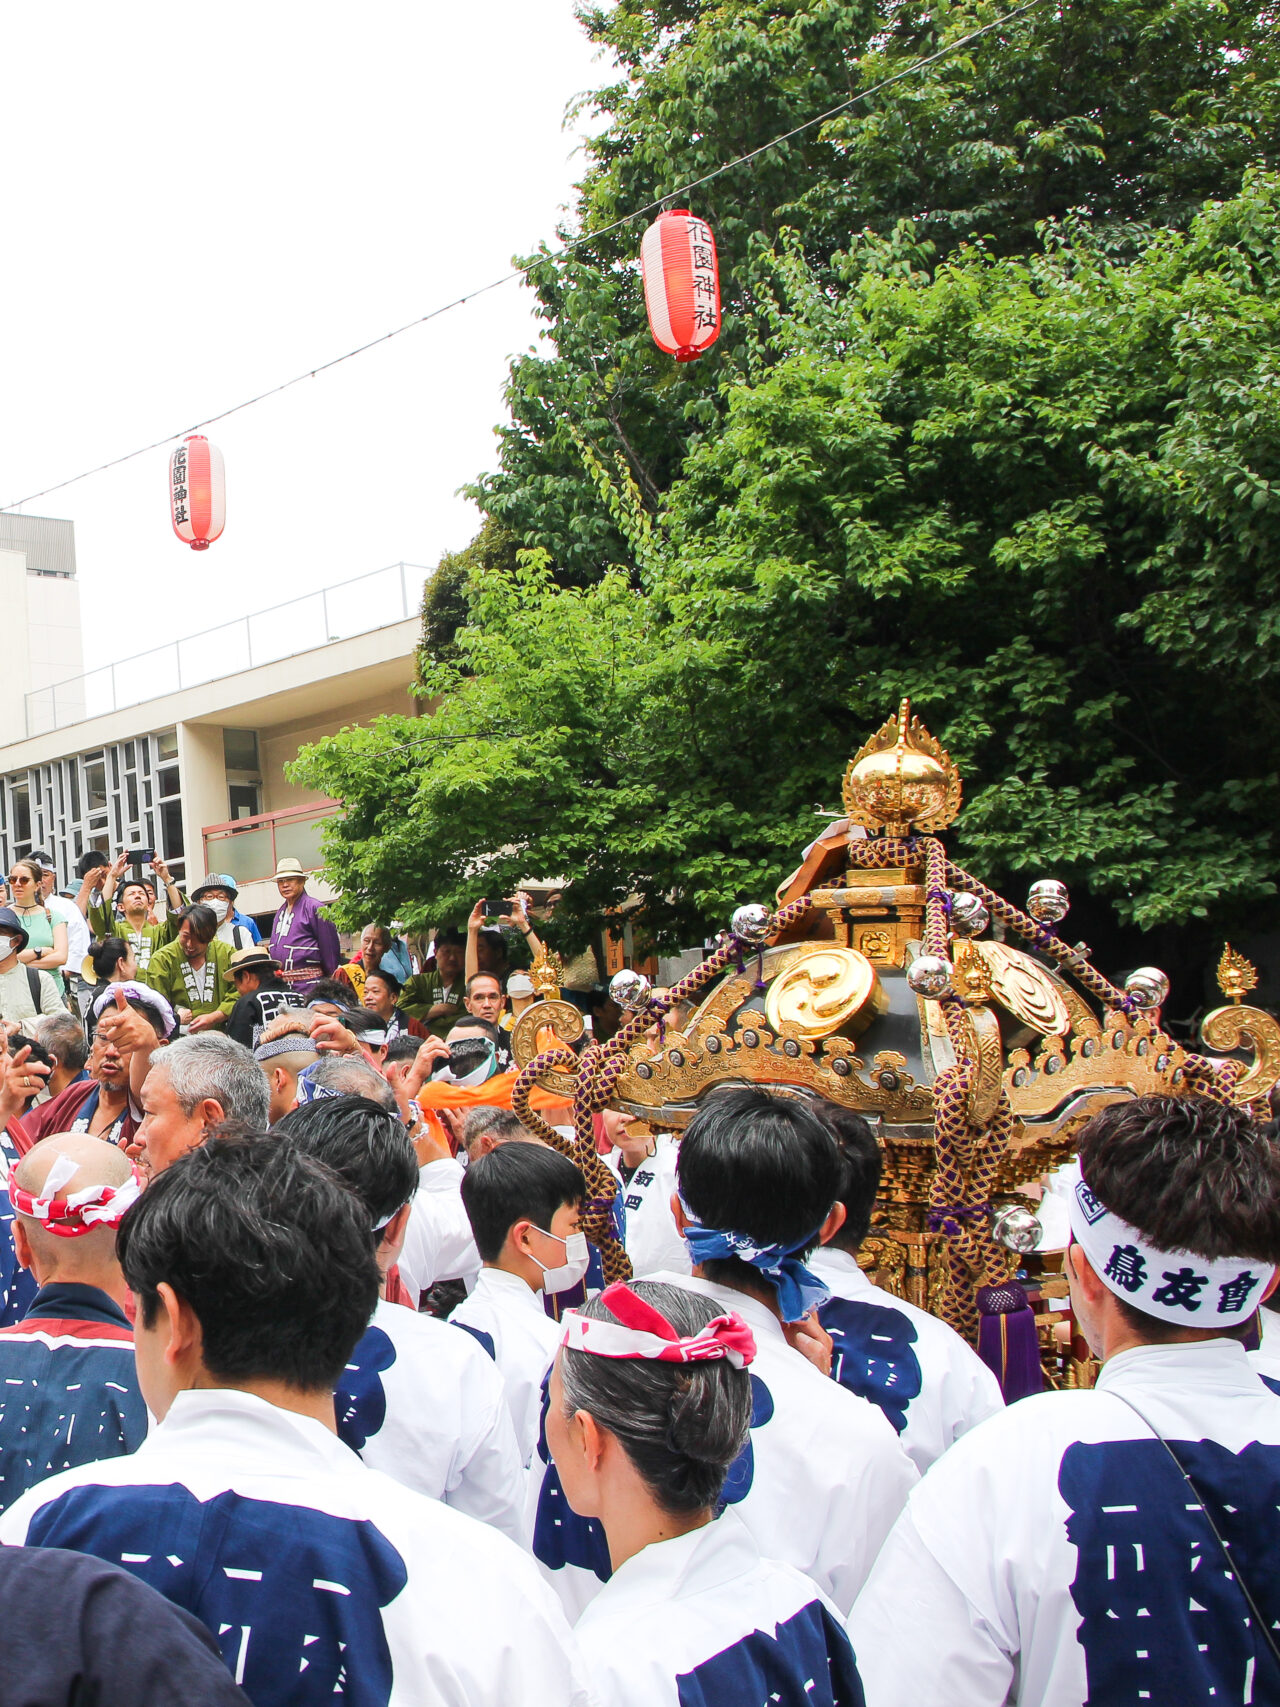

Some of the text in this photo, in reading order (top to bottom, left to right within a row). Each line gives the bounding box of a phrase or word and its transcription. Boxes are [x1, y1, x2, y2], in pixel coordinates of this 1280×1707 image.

[685, 220, 718, 330] 花園神社
[173, 446, 189, 526] 花園神社
